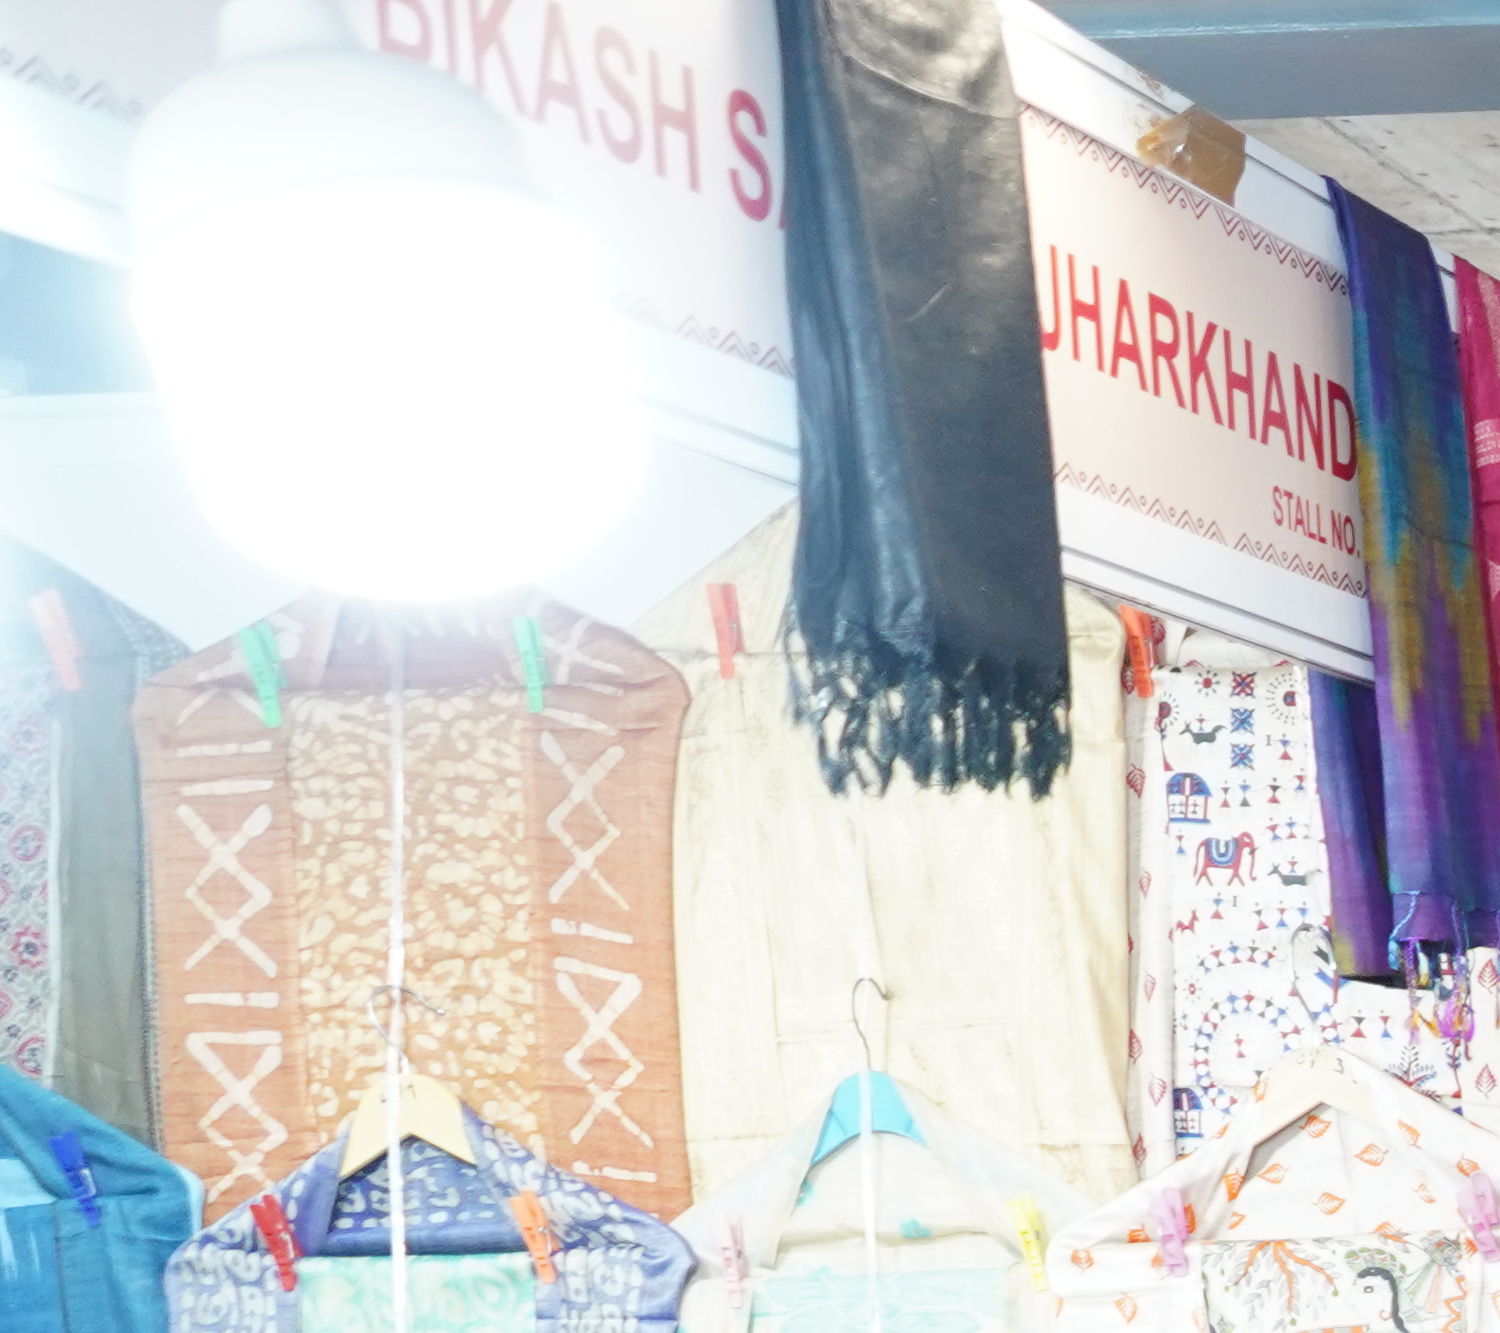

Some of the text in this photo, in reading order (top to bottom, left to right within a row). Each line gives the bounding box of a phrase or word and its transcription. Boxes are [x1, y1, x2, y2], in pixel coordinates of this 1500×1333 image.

[727, 88, 788, 230] S
[1040, 244, 1358, 482] JHARKHAND
[1272, 485, 1361, 558] STALL NO.
